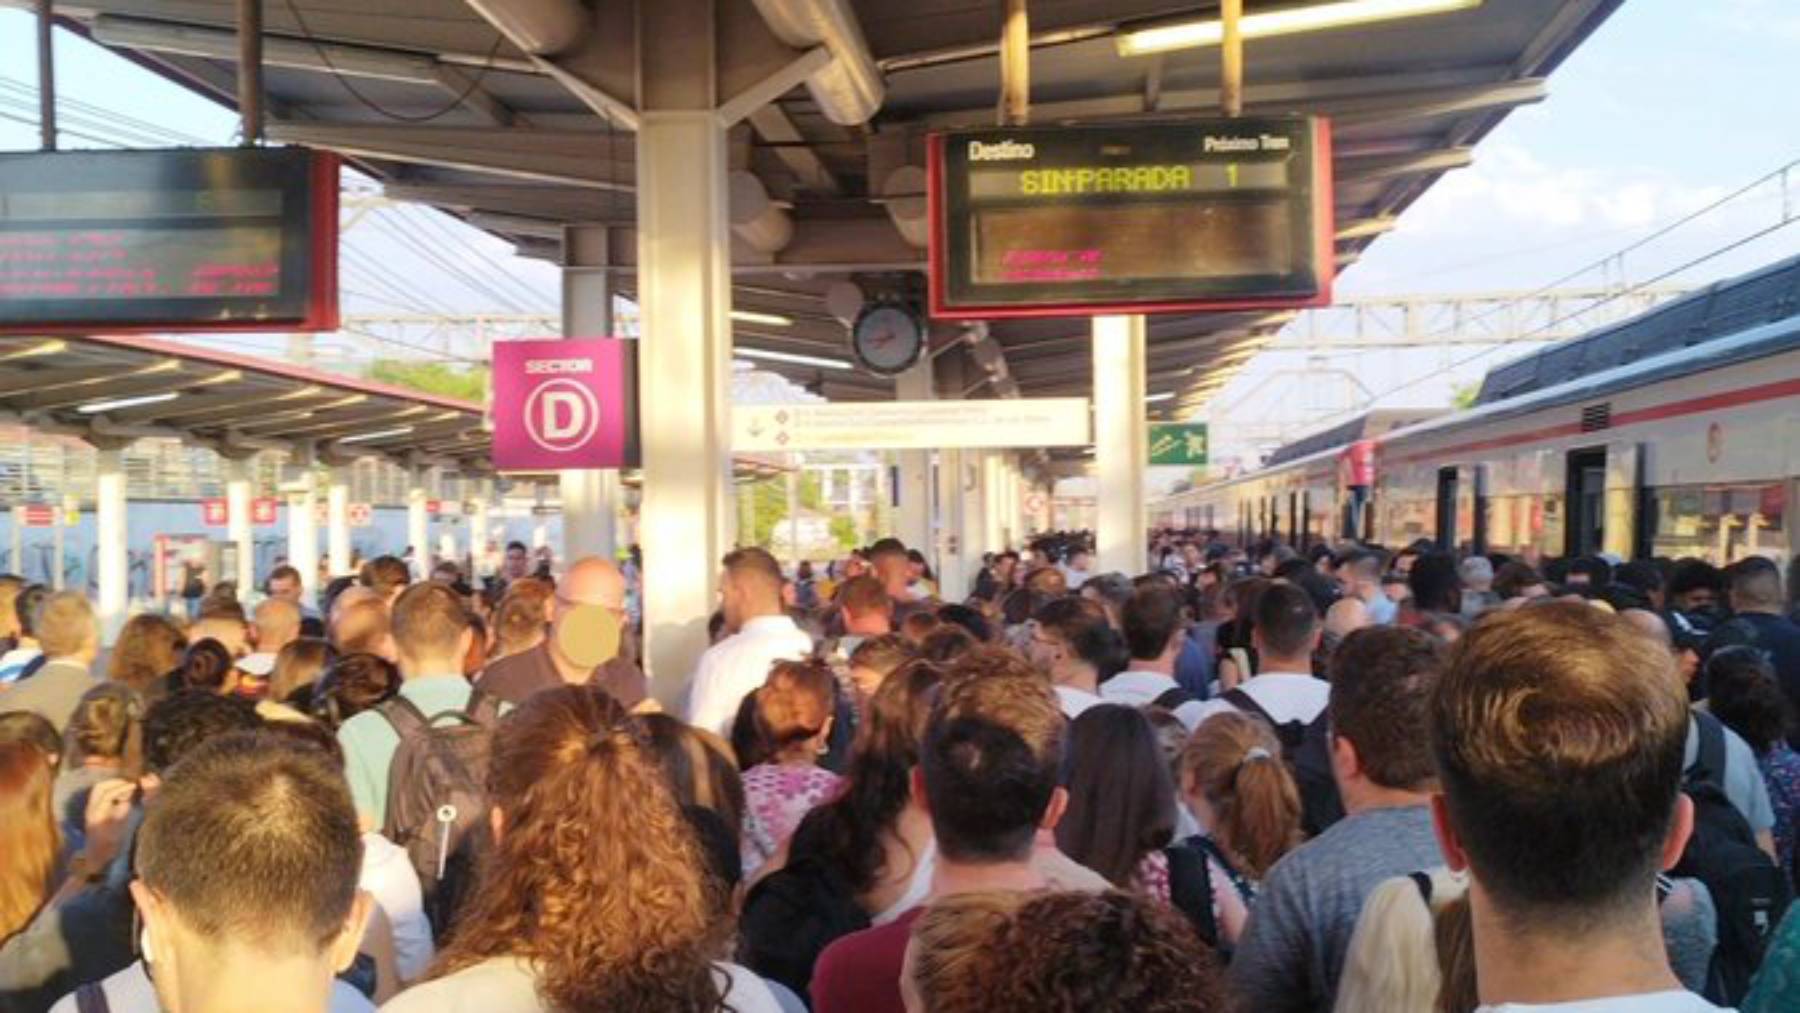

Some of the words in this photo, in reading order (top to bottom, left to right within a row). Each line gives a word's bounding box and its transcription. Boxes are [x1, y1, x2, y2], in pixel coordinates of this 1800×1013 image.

[968, 139, 1035, 161] Destino
[1225, 163, 1238, 188] 1
[541, 390, 585, 438] D
